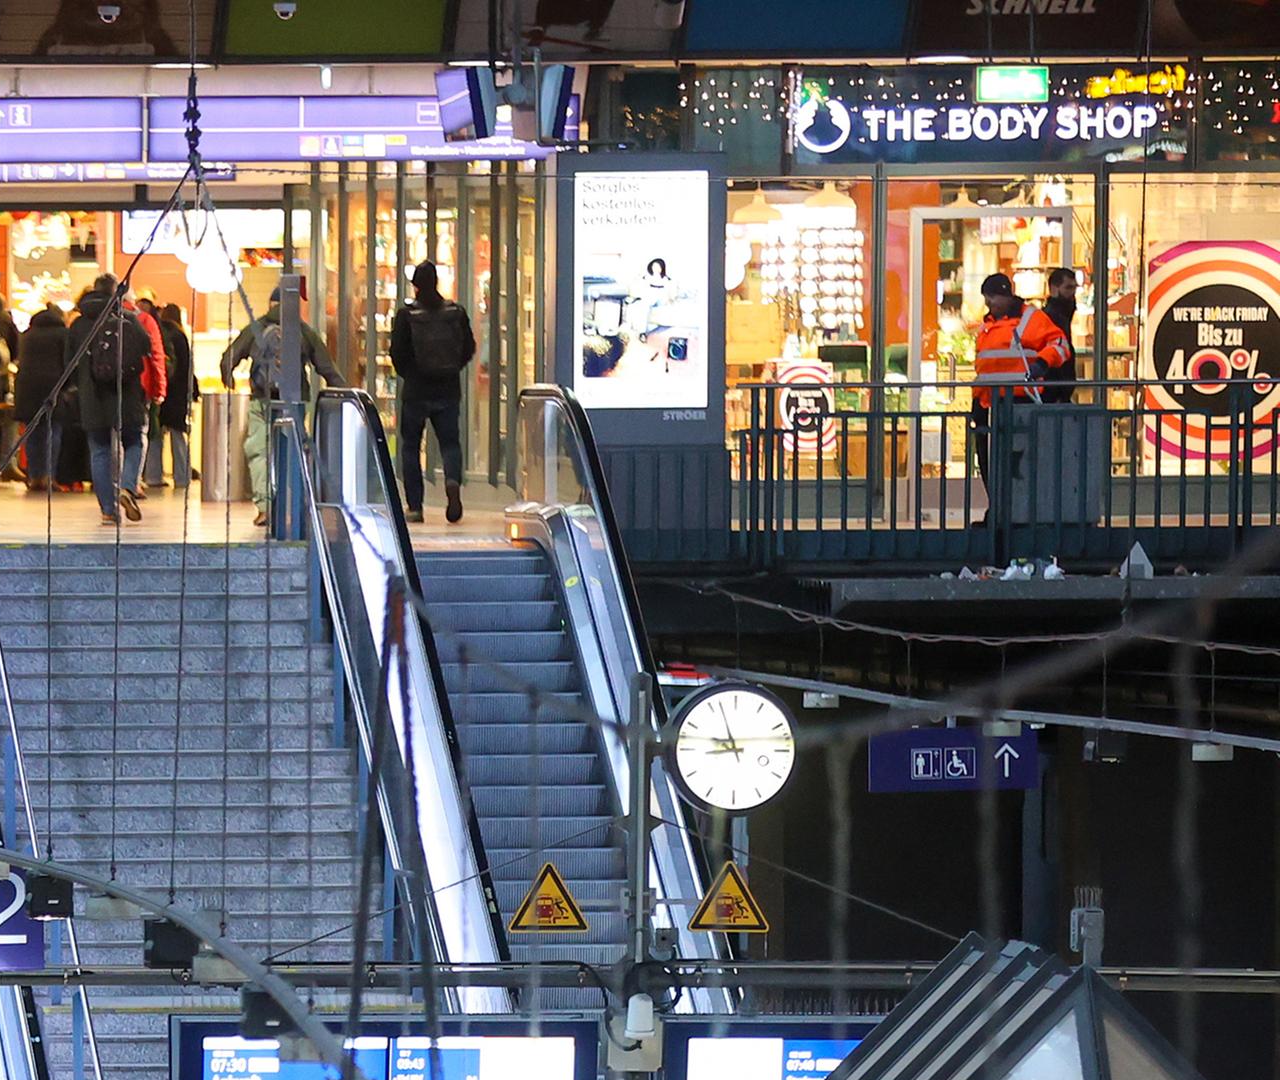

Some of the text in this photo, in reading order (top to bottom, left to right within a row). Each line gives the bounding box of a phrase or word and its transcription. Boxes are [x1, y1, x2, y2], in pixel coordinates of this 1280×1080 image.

[965, 0, 1096, 16] SCHNELL
[863, 105, 1158, 142] THE BODY SHOP
[1172, 305, 1269, 322] WE'RE BLACK FRIDAY
[1197, 322, 1243, 347] Bis zu
[1165, 348, 1274, 395] 40%
